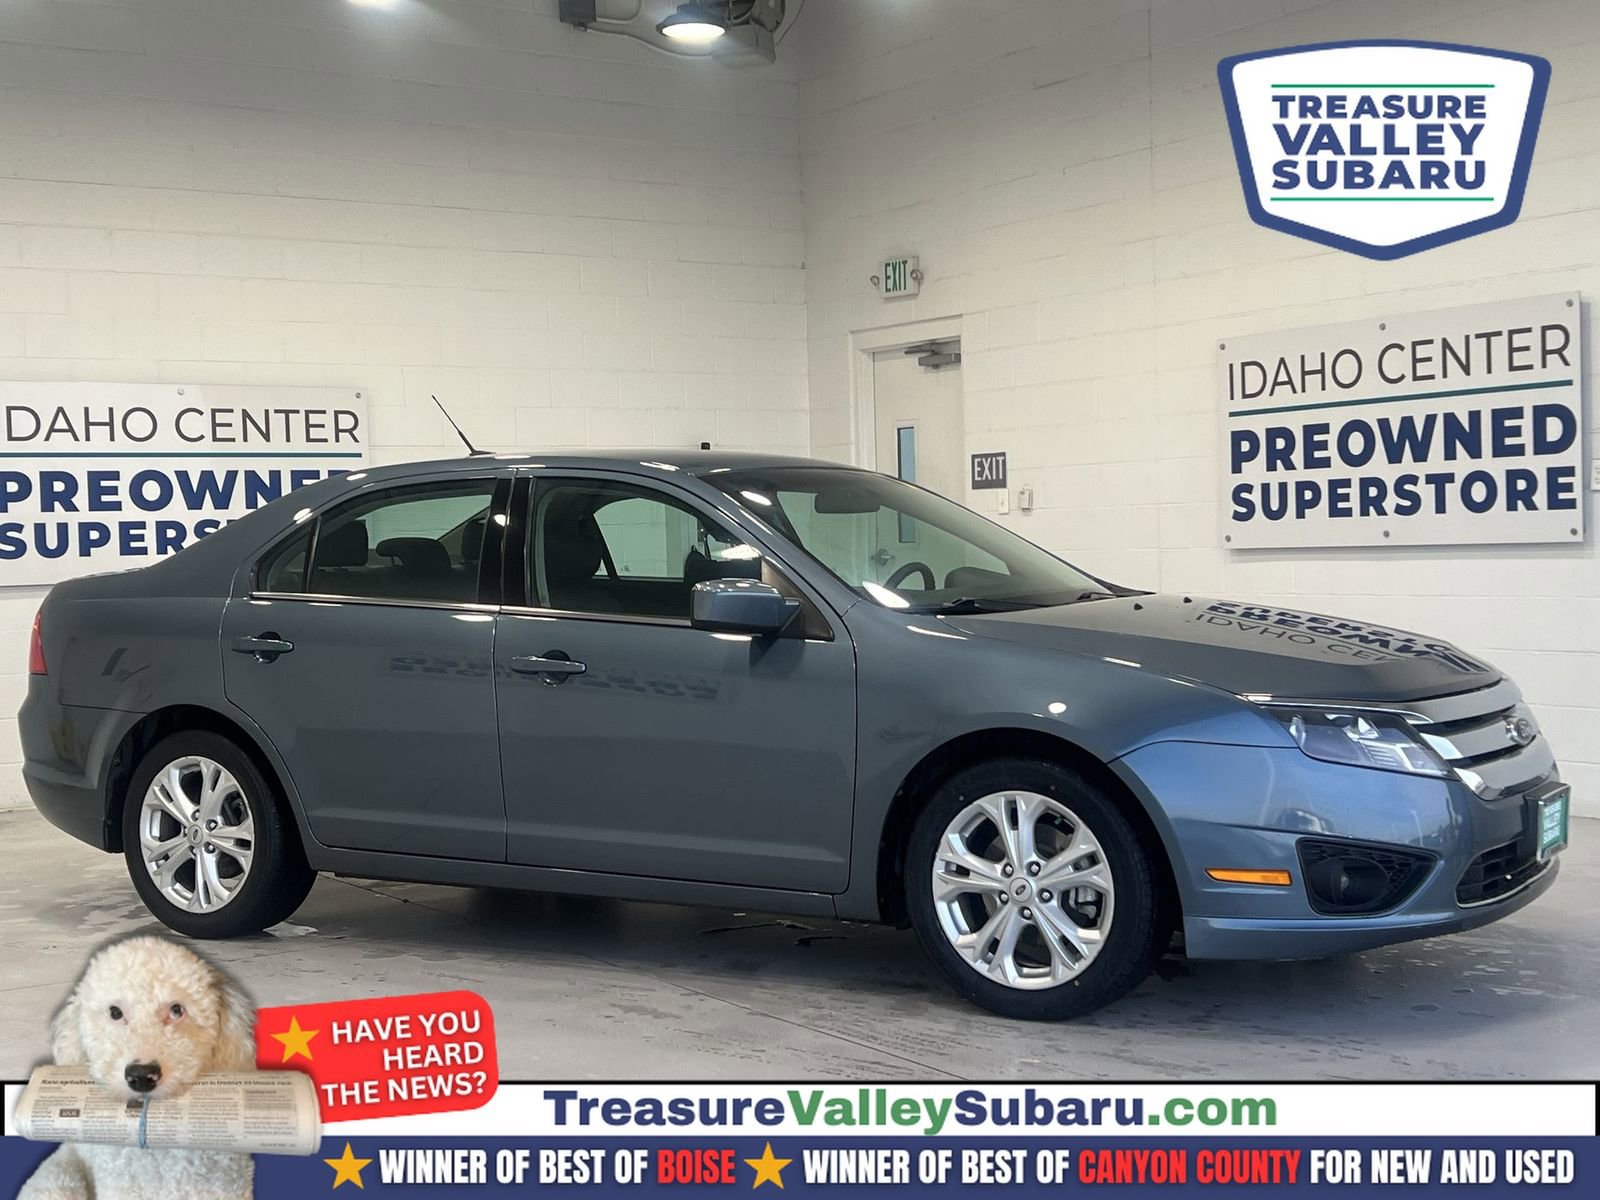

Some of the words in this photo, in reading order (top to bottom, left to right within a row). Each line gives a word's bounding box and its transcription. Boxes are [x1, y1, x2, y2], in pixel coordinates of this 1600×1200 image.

[884, 260, 908, 293] EXIT
[1228, 348, 1363, 401] IDAHO
[1377, 323, 1572, 384] CENTER
[4, 405, 158, 442] DAHO
[174, 406, 361, 443] CENTER
[1230, 403, 1578, 474] PREOWNED
[973, 456, 1005, 481] EXIT
[1231, 465, 1578, 522] SUPERSTORE
